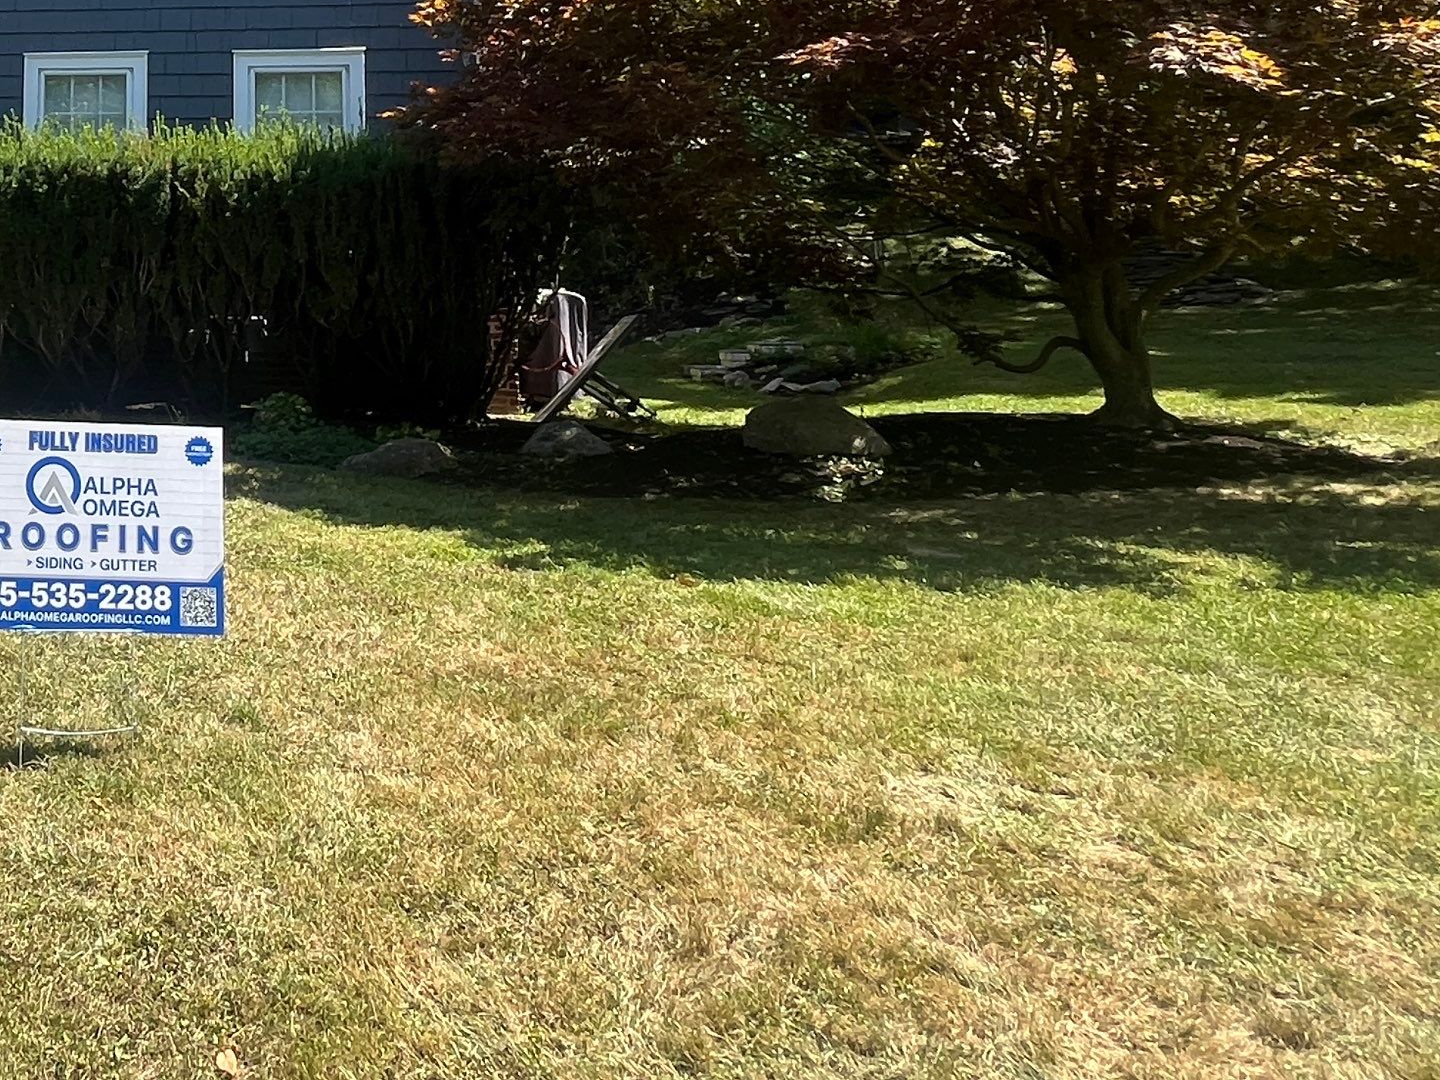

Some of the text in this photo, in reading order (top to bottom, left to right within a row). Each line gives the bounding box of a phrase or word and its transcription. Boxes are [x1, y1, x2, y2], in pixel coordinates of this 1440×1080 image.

[28, 430, 159, 454] FULLY INSURED
[83, 476, 159, 496] ALPHA
[83, 498, 160, 518] OMEGA
[35, 556, 158, 572] SIDING GUTTER
